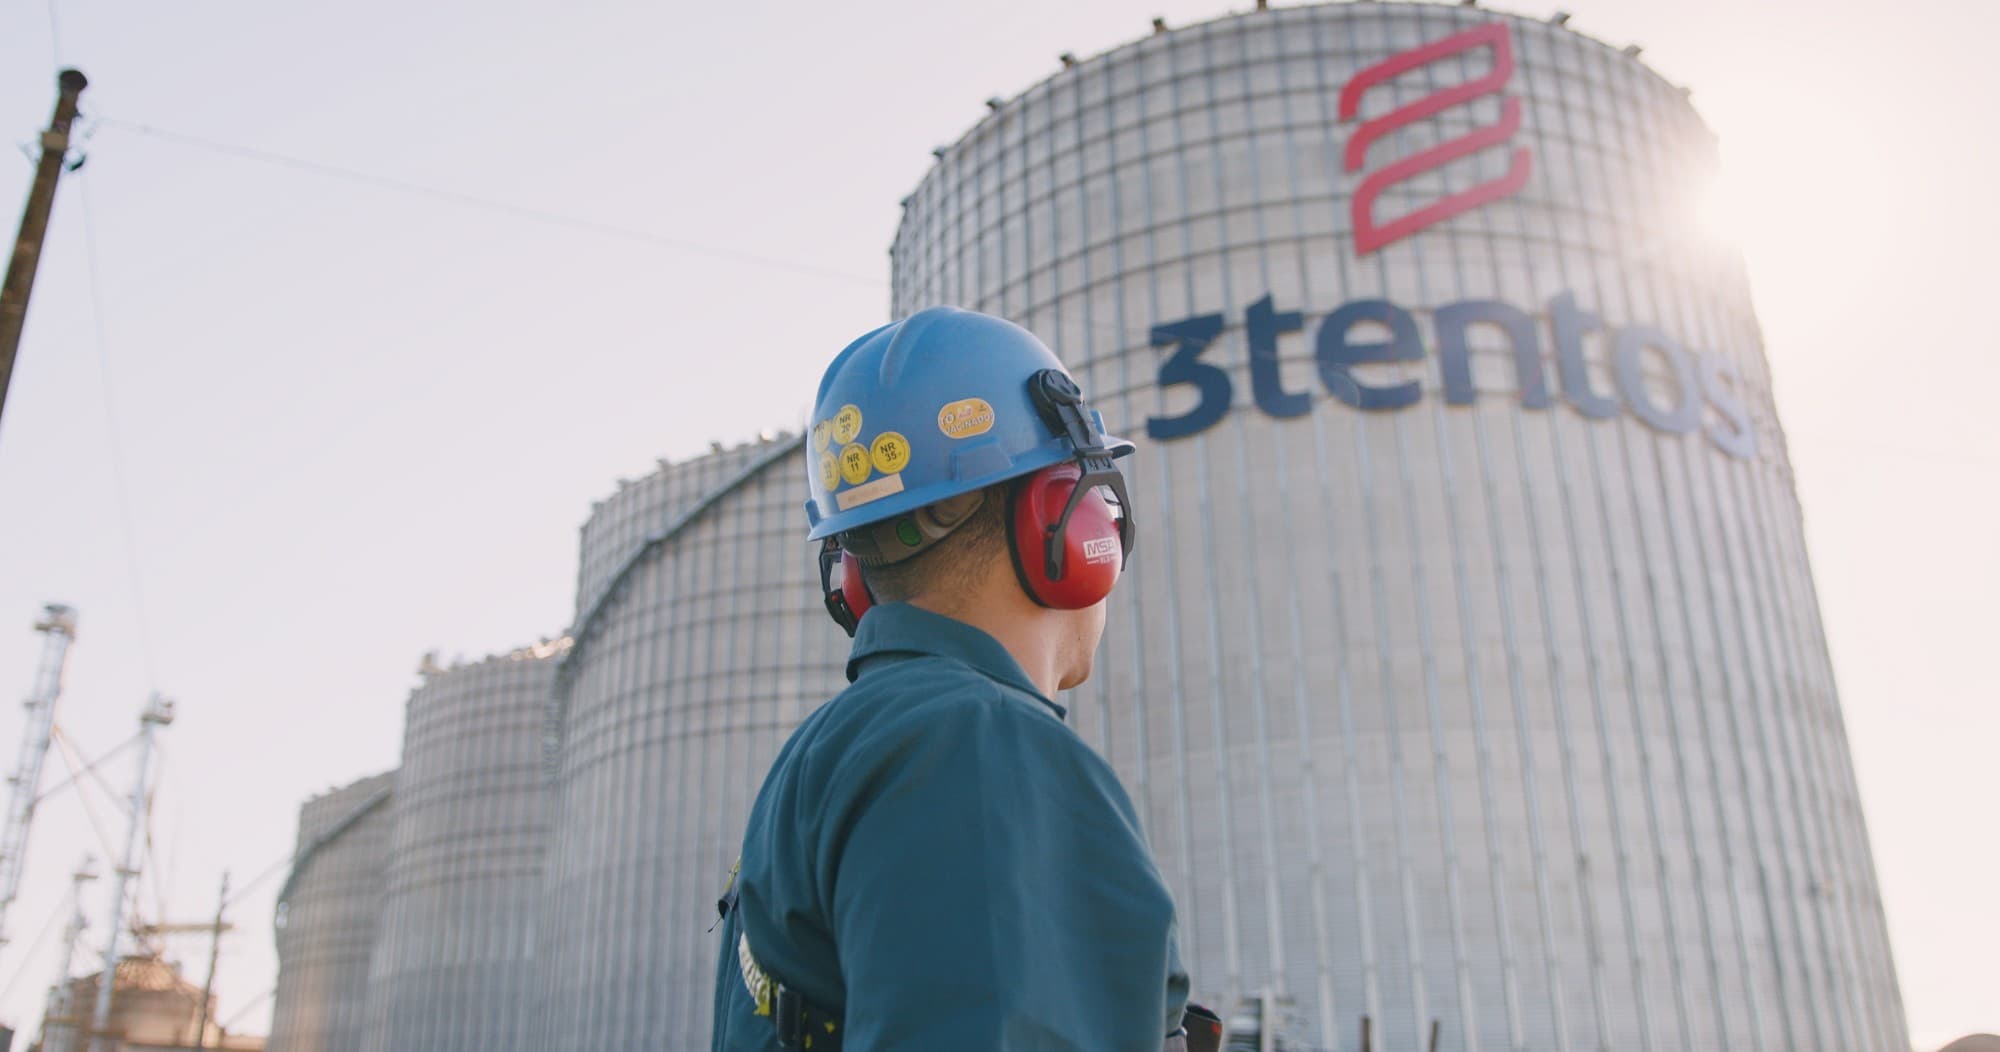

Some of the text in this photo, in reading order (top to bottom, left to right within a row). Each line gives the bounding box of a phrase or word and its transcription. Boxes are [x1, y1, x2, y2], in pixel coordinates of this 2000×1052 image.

[1146, 289, 1758, 460] 3tentos
[880, 441, 896, 454] NR
[846, 452, 860, 464] NR
[885, 451, 897, 462] 35
[850, 461, 859, 472] 11
